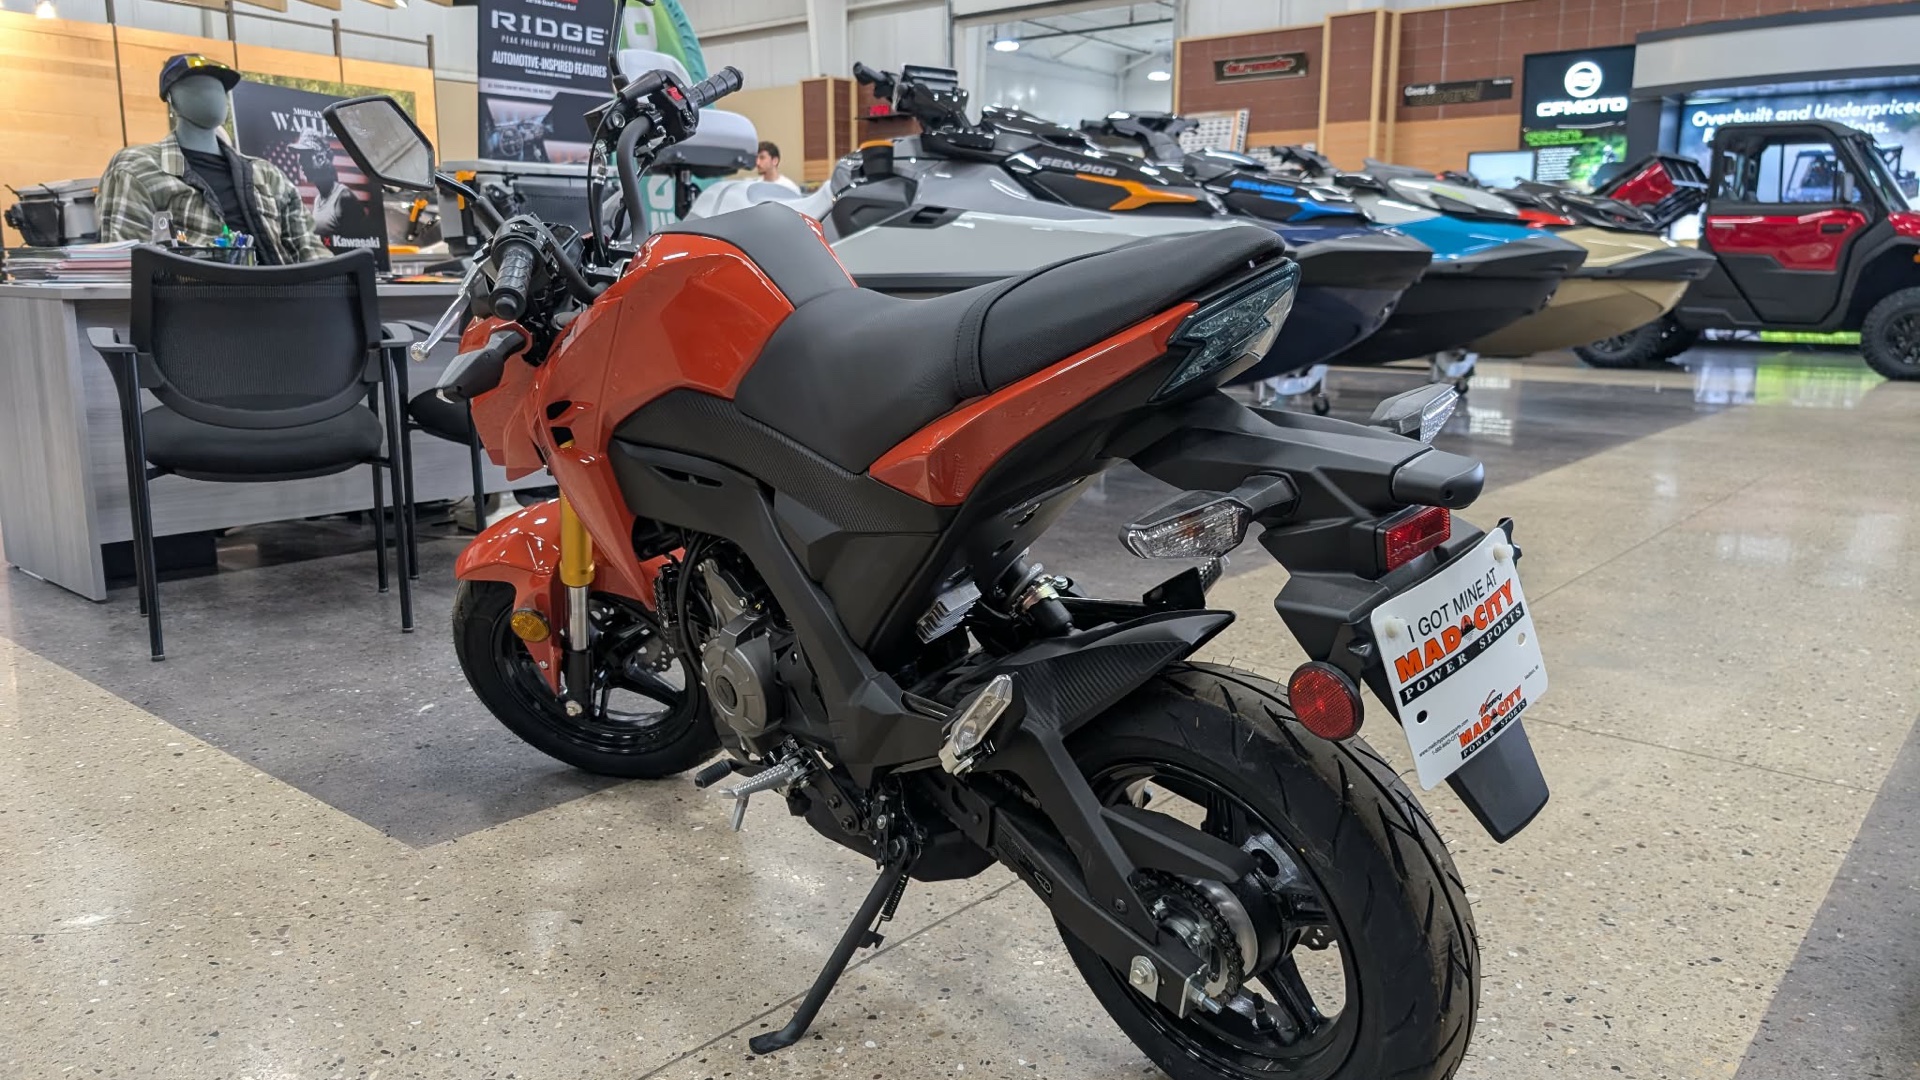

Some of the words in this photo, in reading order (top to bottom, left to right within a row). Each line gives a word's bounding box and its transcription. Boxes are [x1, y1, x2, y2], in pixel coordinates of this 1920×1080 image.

[491, 10, 605, 46] RIDGE
[501, 35, 518, 45] PEAK
[521, 36, 550, 49] PREMIUM
[553, 42, 596, 57] PERFORMANCE
[492, 50, 573, 74] AUTOMOTIVE-INSPIRED
[574, 62, 608, 78] FEATURES
[1536, 97, 1628, 117] CFMOTO
[1692, 106, 1774, 127] Overbuilt
[1775, 104, 1812, 120] and
[333, 235, 380, 248] Kawasaki
[1407, 624, 1415, 643] I
[1418, 603, 1449, 636] GOT
[1452, 579, 1485, 616] MINE
[1485, 567, 1498, 592] AT
[1473, 578, 1514, 631] CITY
[1403, 652, 1468, 701] POWER
[1479, 605, 1523, 650] SPORTS
[1497, 684, 1522, 717] CITY
[1463, 730, 1496, 757] POWER
[1500, 700, 1526, 727] SPORTS
